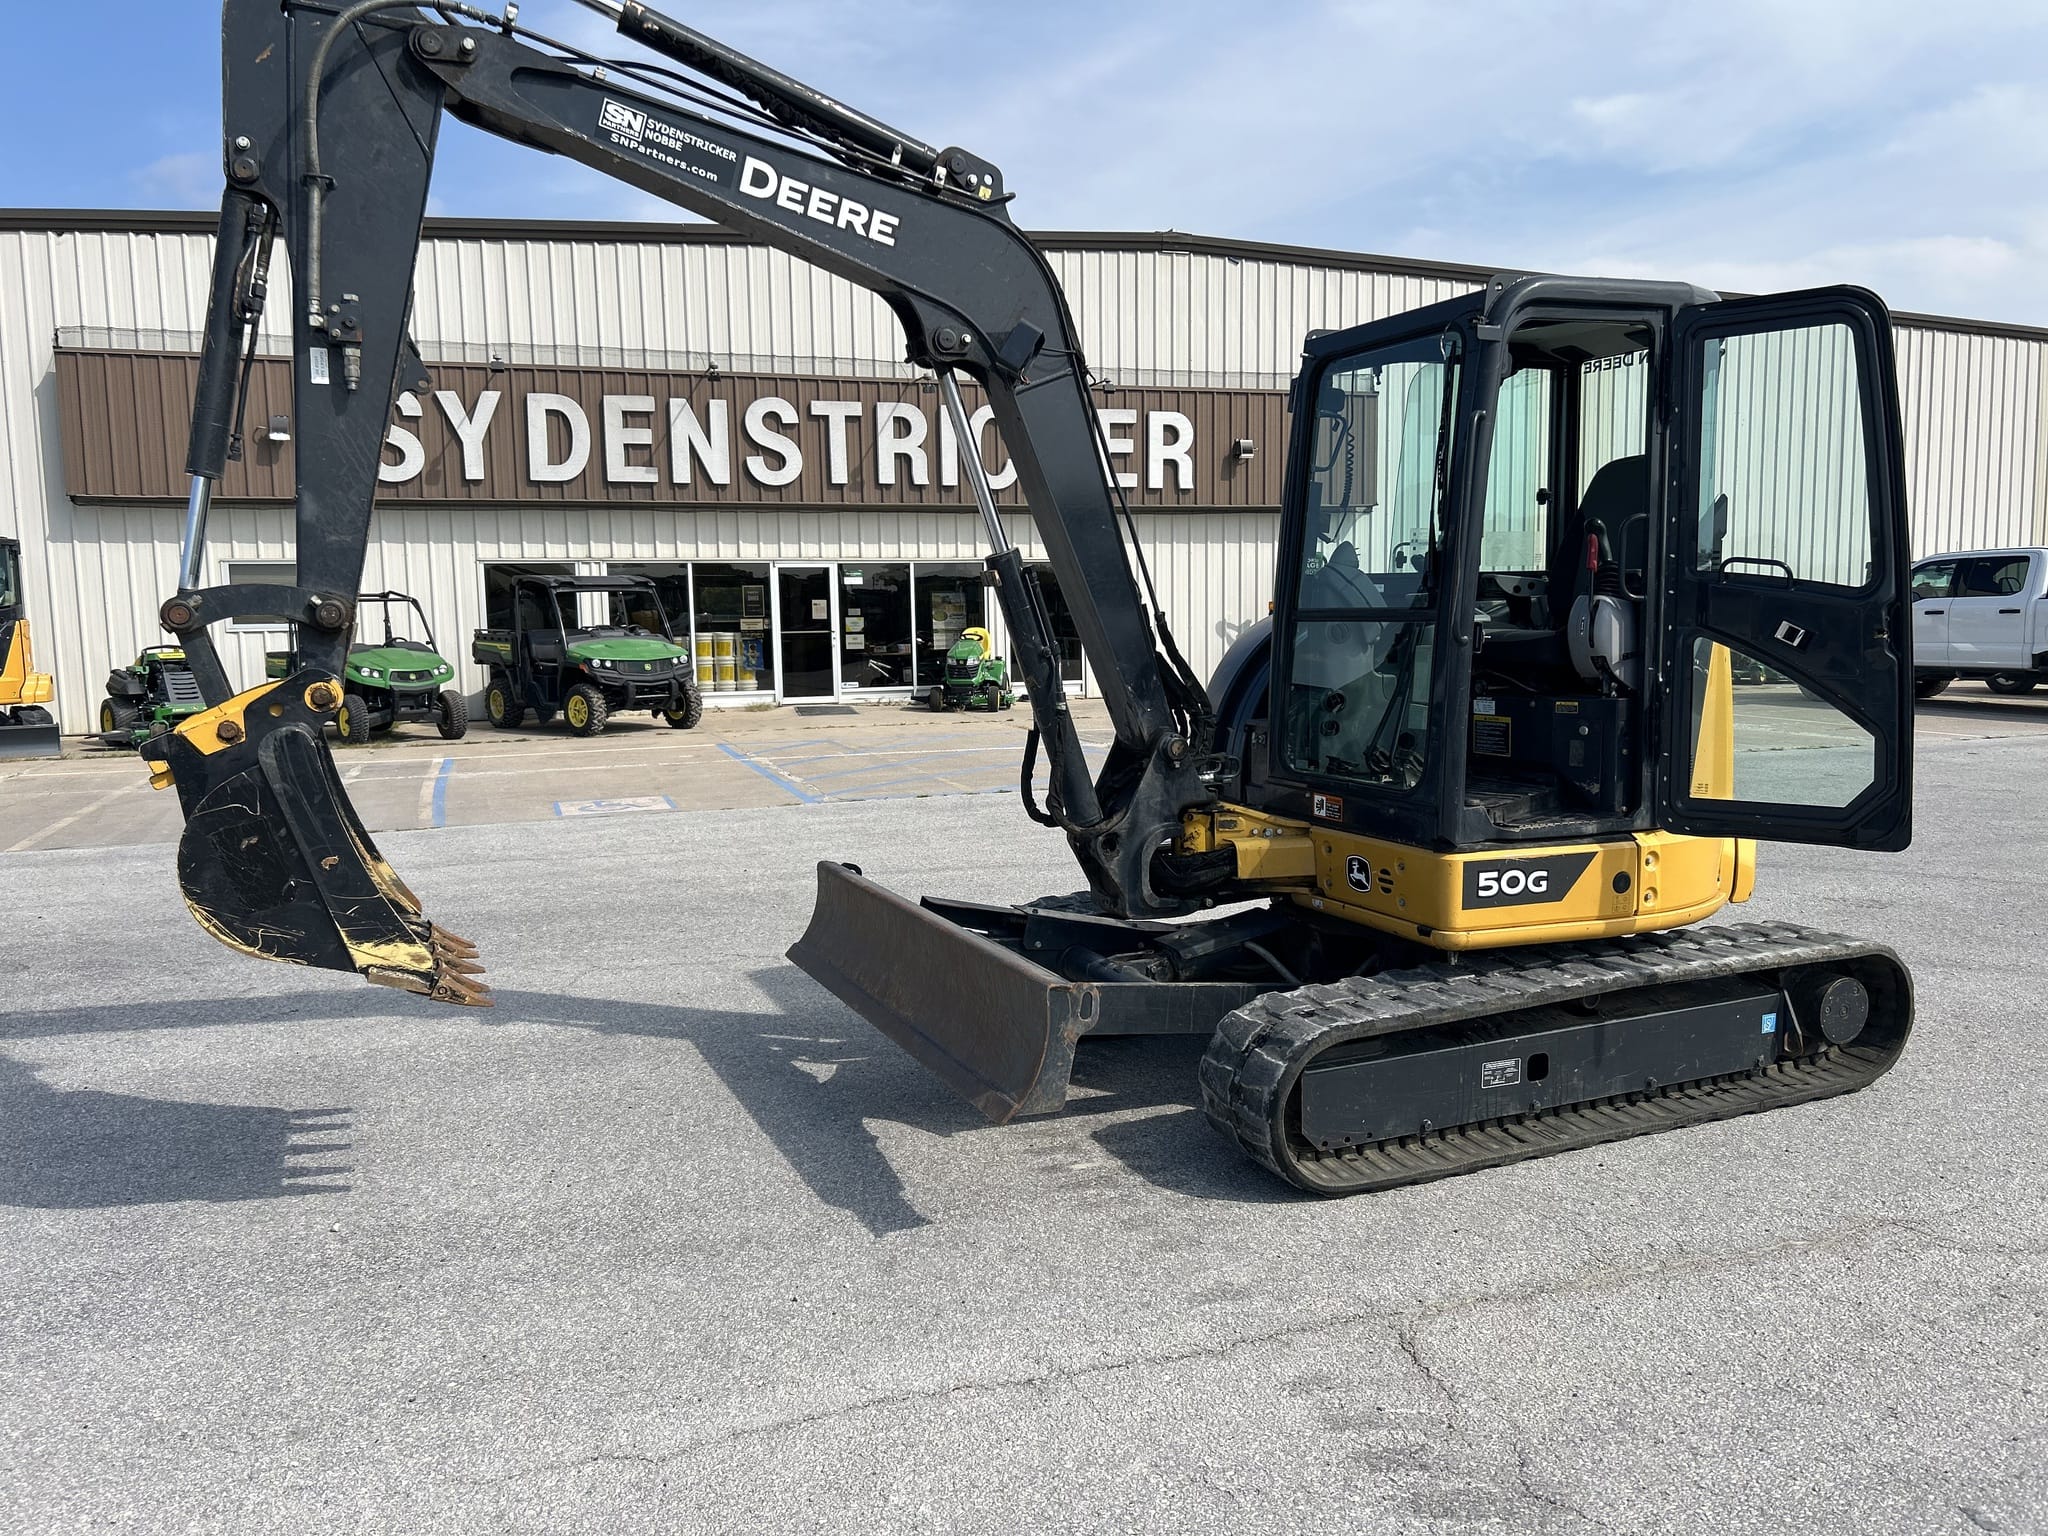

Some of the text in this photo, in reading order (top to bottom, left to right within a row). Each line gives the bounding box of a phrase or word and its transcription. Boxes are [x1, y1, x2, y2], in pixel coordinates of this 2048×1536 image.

[602, 118, 640, 137] PARTNERS
[604, 103, 643, 132] SN
[610, 133, 718, 182] SNPartners.com
[644, 128, 684, 152] NOBBE
[646, 118, 737, 163] SYDENSTRICKER
[739, 156, 899, 247] DEERE
[377, 390, 1194, 489] SYDENSTRICER
[1478, 869, 1549, 897] 50G
